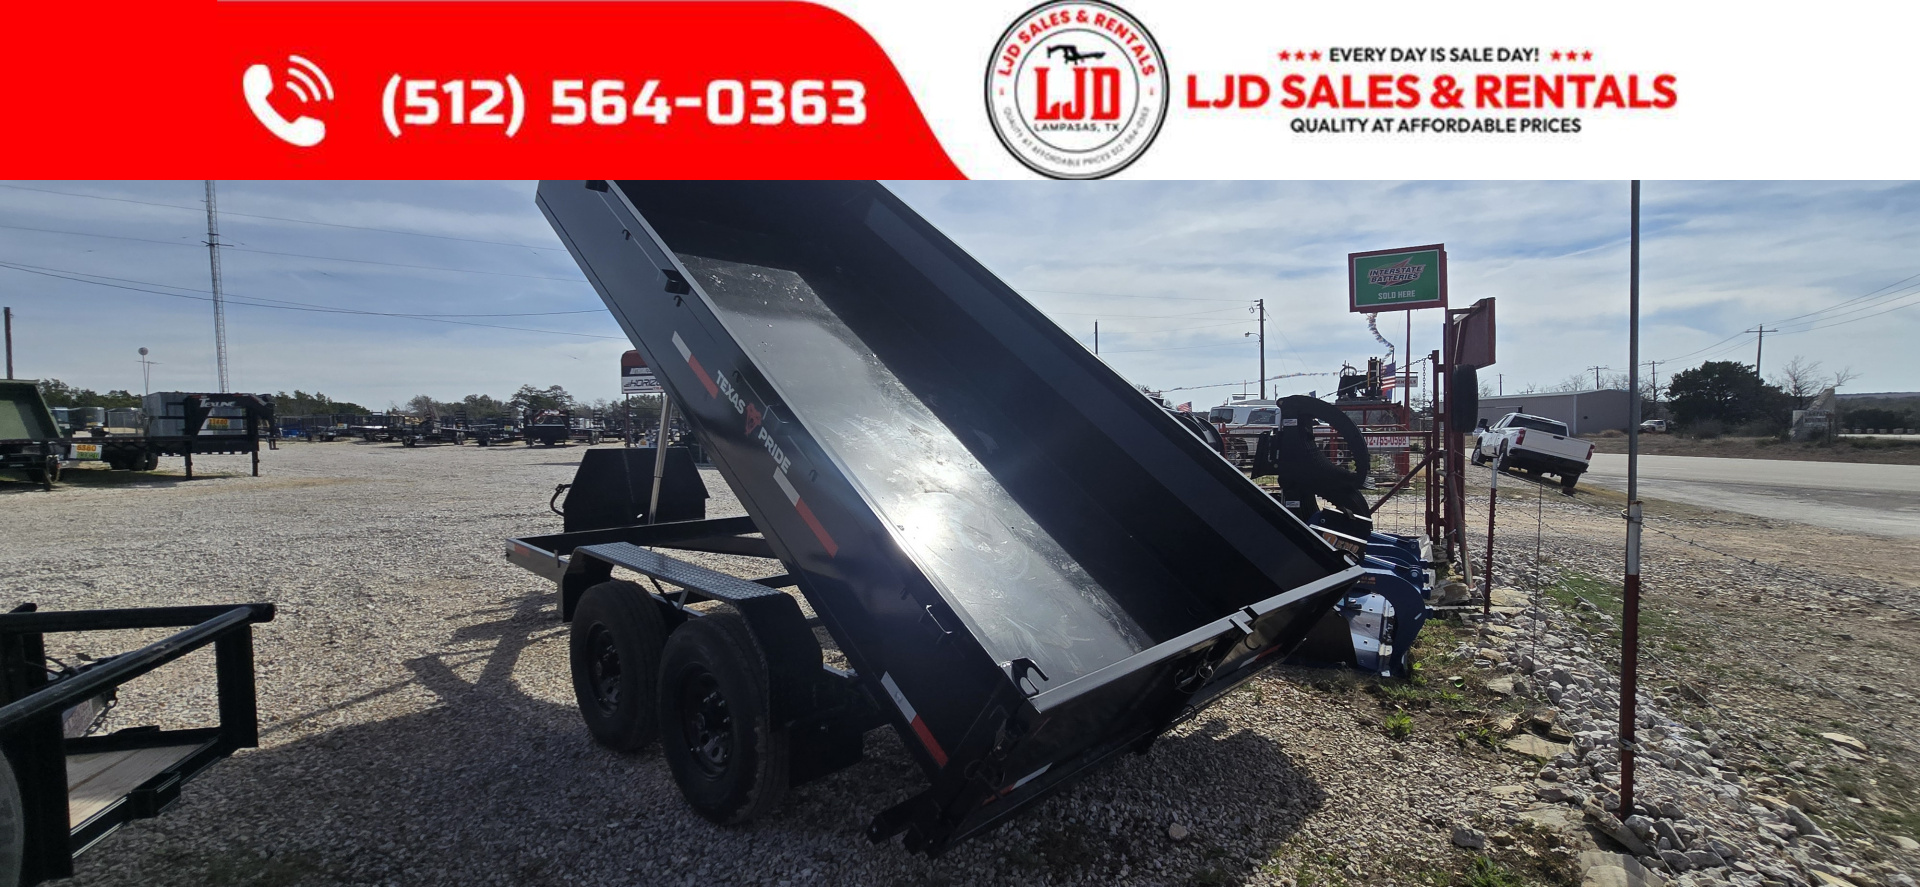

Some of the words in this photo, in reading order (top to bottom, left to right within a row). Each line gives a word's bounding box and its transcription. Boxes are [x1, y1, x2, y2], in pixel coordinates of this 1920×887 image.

[1369, 265, 1424, 277] INTERSTATE
[1370, 273, 1419, 284] BATTERIES
[1378, 292, 1396, 300] SOLD
[1398, 290, 1416, 298] HERE
[715, 369, 747, 415] TEXAS
[757, 426, 792, 474] PRIDE
